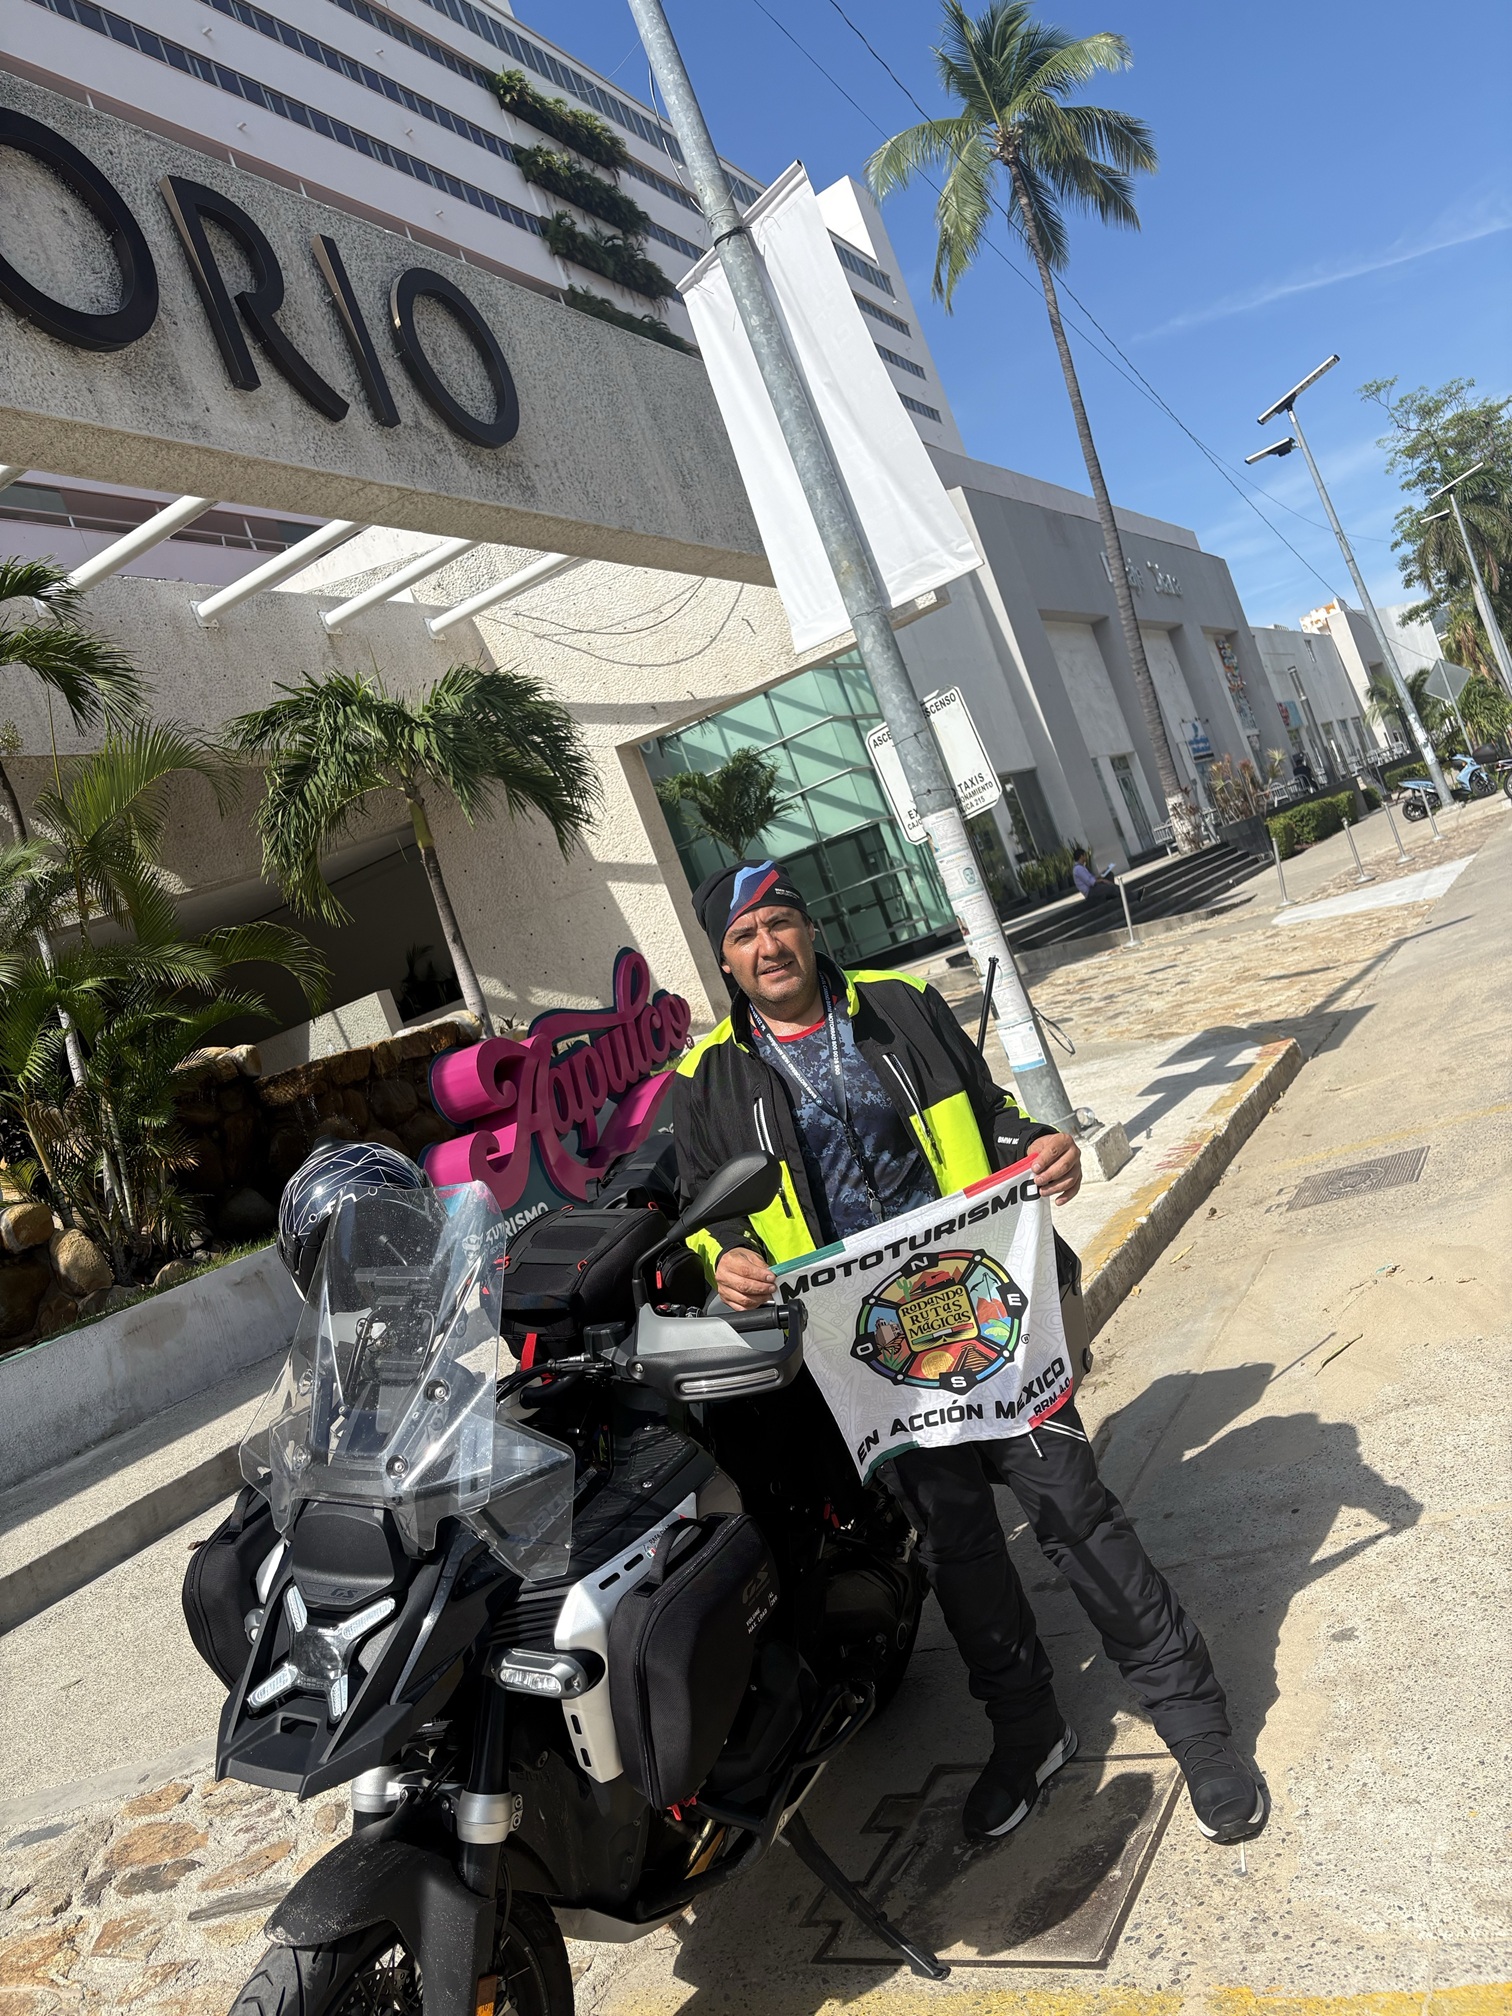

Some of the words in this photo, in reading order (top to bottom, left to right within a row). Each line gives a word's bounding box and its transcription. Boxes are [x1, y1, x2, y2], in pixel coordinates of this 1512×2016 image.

[873, 731, 893, 749] ASCE
[922, 692, 957, 719] SCENSO
[957, 772, 985, 793] TAXIS
[957, 781, 994, 803] ONAMIENTO
[975, 796, 986, 807] 215
[424, 948, 692, 1210] Aapulco
[779, 1179, 1042, 1300] MOTOTURISMO
[911, 1256, 929, 1271] N
[1006, 1293, 1022, 1306] E
[951, 1376, 967, 1388] S
[1033, 1391, 1058, 1417] RRM
[857, 1429, 880, 1466] EN
[890, 1400, 983, 1436] ACCIÓN
